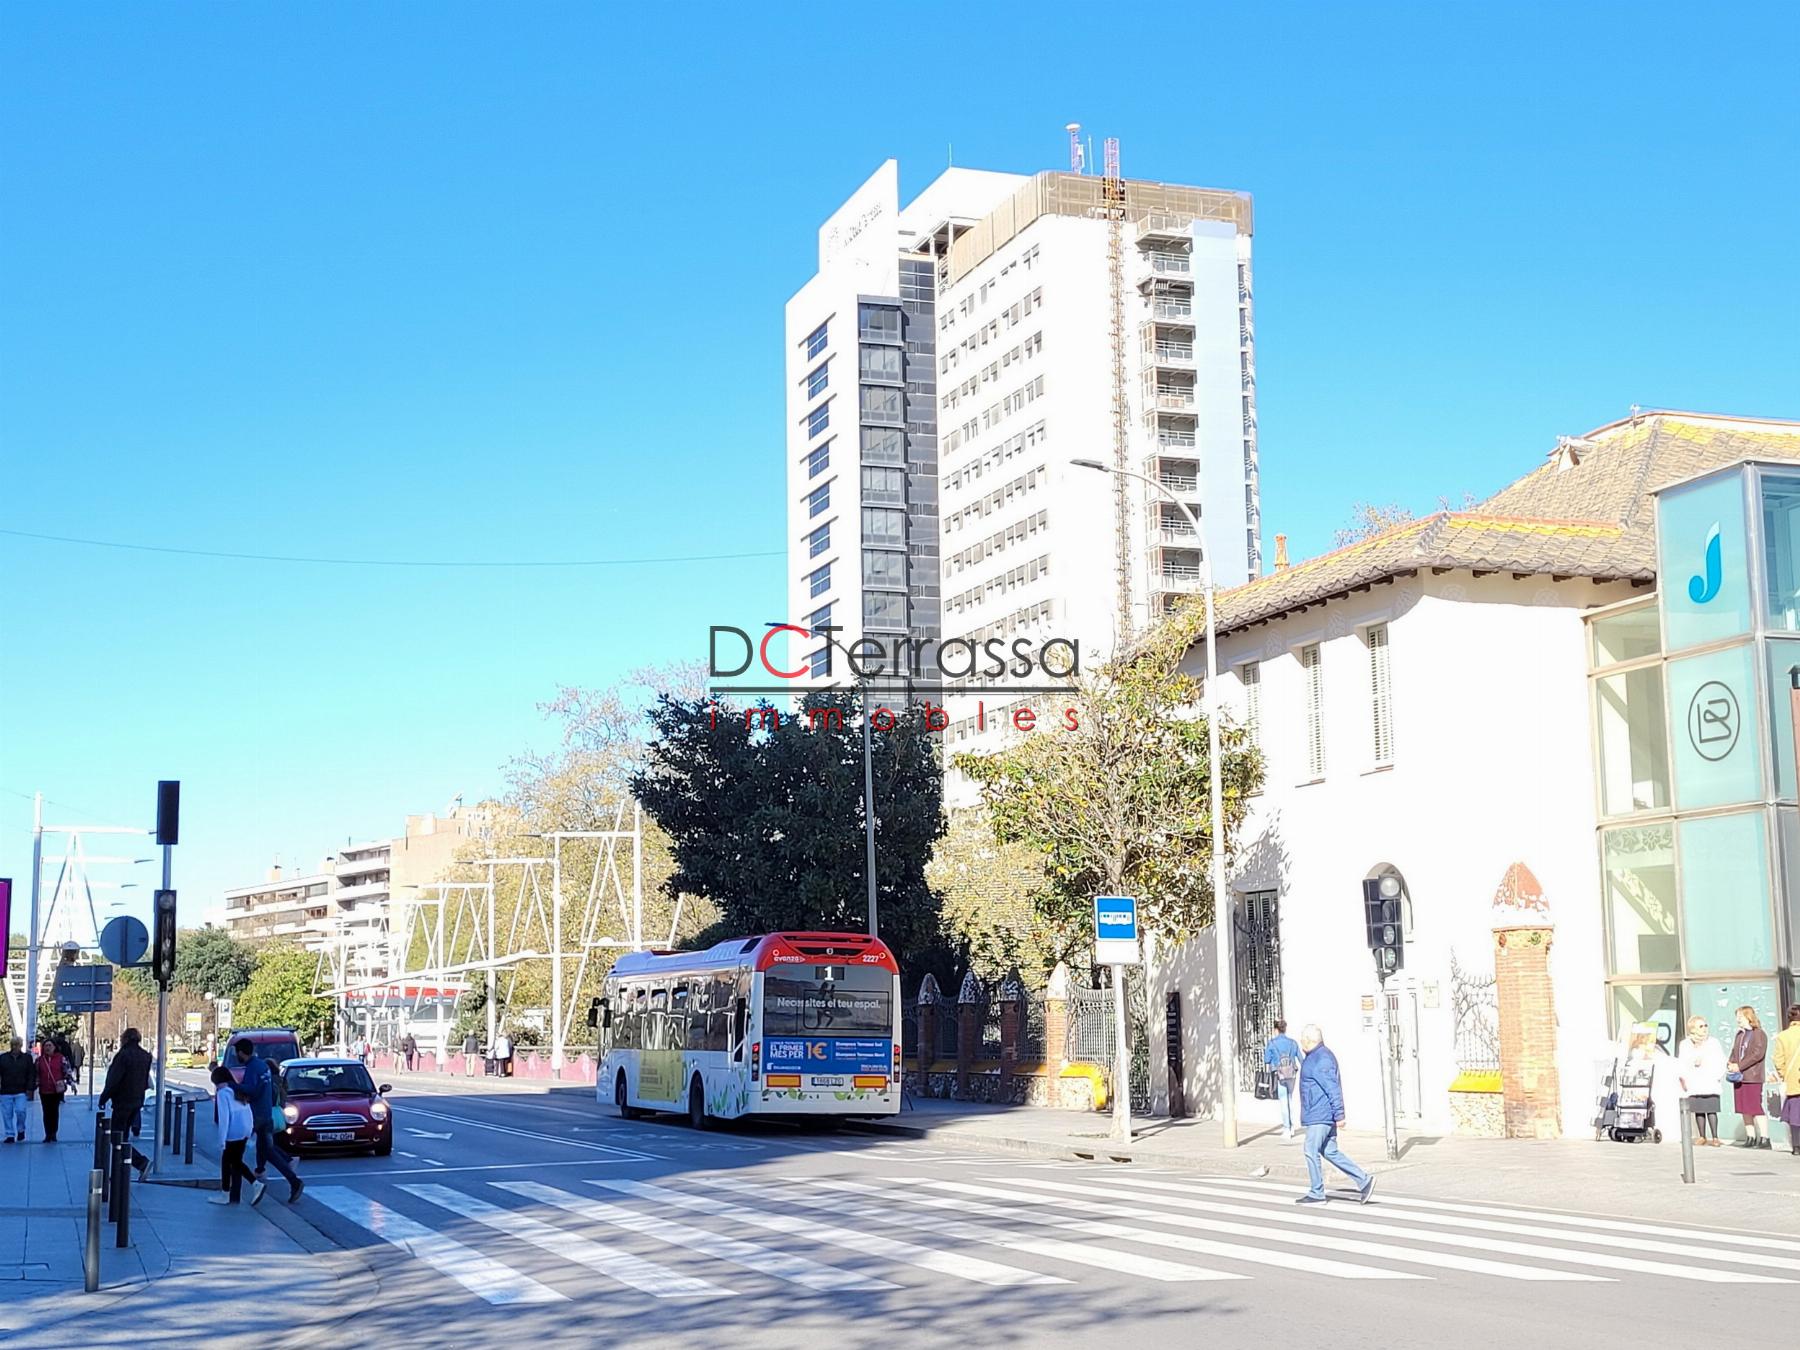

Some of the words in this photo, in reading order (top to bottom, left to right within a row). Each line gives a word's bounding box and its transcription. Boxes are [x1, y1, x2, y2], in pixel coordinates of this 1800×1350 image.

[862, 954, 879, 963] 2227
[824, 965, 834, 981] 1
[827, 998, 836, 1009] el
[837, 999, 852, 1009] teu
[770, 1044, 777, 1052] EL
[779, 1044, 804, 1052] PRIMER
[805, 1041, 828, 1060] 1€
[788, 1051, 804, 1059] PER
